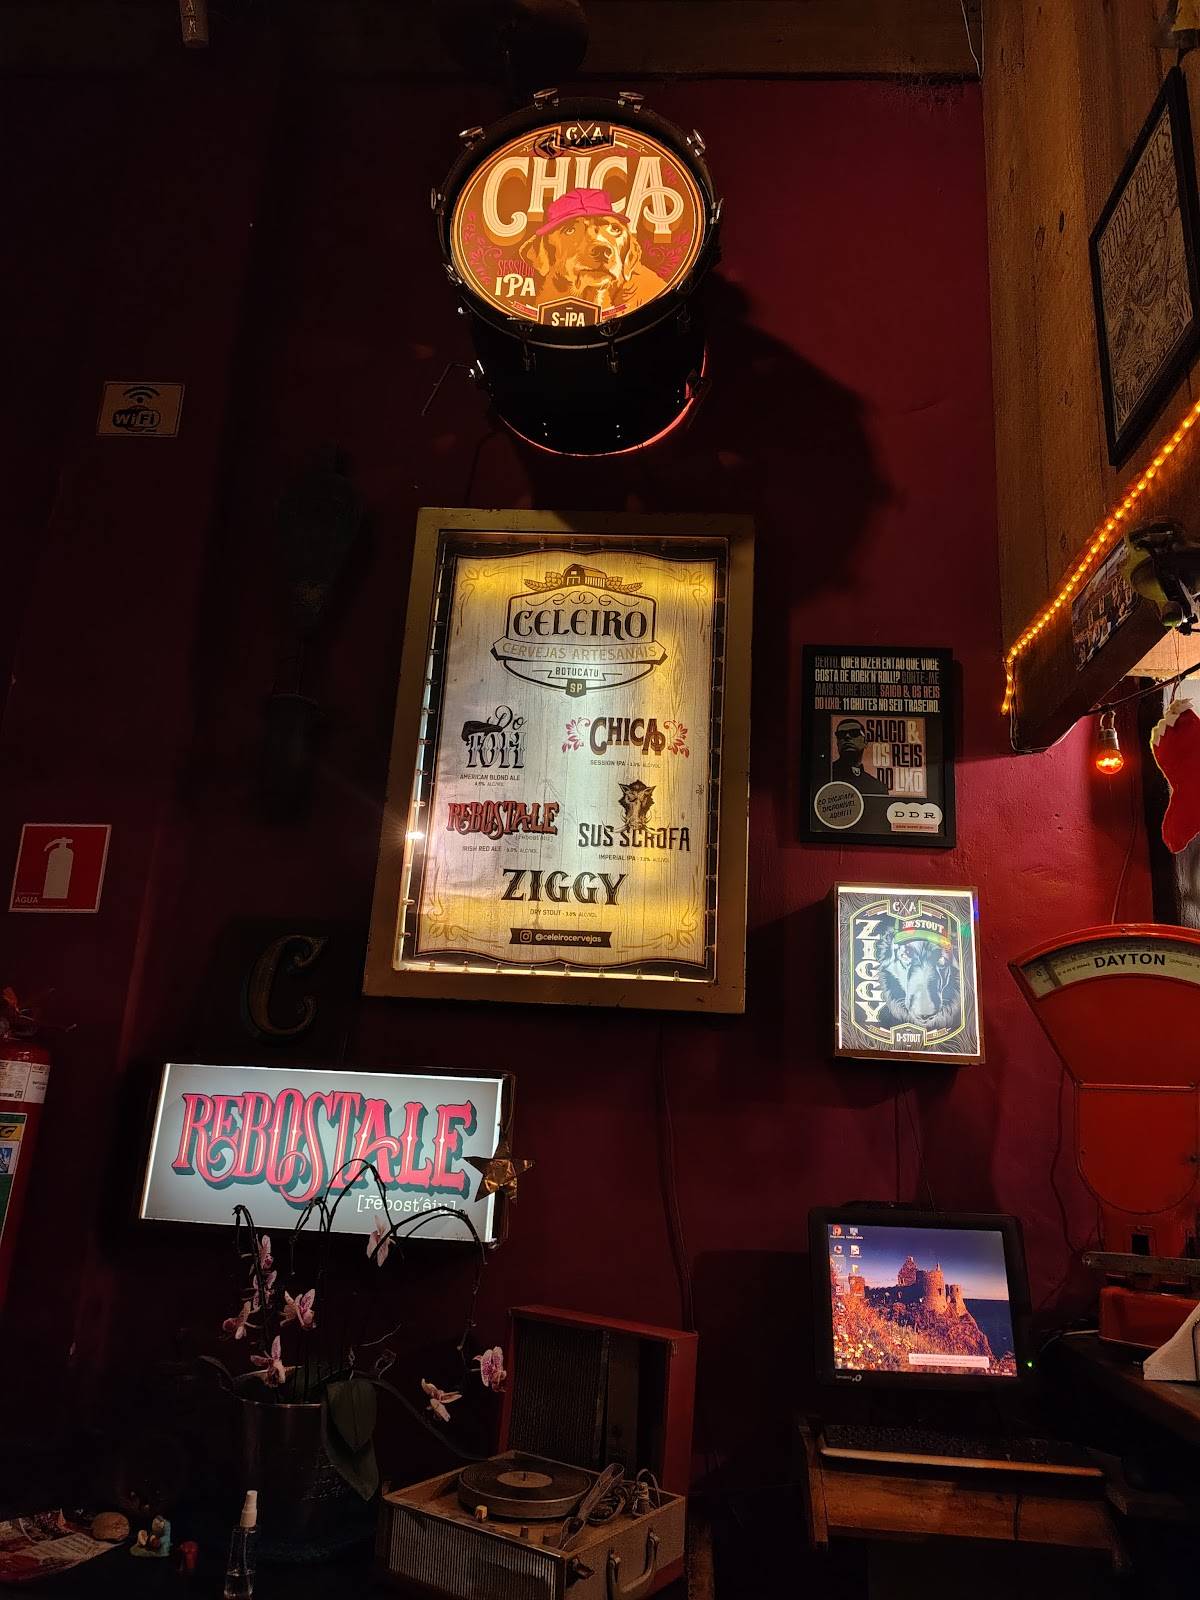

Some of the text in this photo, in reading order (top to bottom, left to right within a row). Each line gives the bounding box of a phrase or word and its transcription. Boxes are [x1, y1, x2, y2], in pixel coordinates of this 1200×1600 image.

[482, 155, 685, 240] CHICA
[494, 273, 536, 298] IPA
[551, 311, 586, 328] S-IPA
[513, 608, 648, 641] CELEIRO
[502, 641, 658, 662] CERVEJAS ARTESANAIS
[840, 656, 859, 670] QUER
[905, 657, 920, 672] QUE
[555, 666, 600, 678] BOTUCATU
[840, 669, 849, 683] DE
[569, 683, 583, 694] SP
[589, 716, 666, 756] CHICA
[872, 742, 923, 768] OS REIS
[446, 799, 560, 841] REBOSTALE
[578, 822, 690, 852] SUS SCROFA
[501, 868, 629, 906] ZIGGY
[535, 932, 602, 945] @celeirocervejas
[914, 919, 946, 934] STOUT
[855, 919, 887, 1023] ZIGGY
[1094, 953, 1166, 969] DAYTON
[171, 1088, 478, 1211] REBOSTALE
